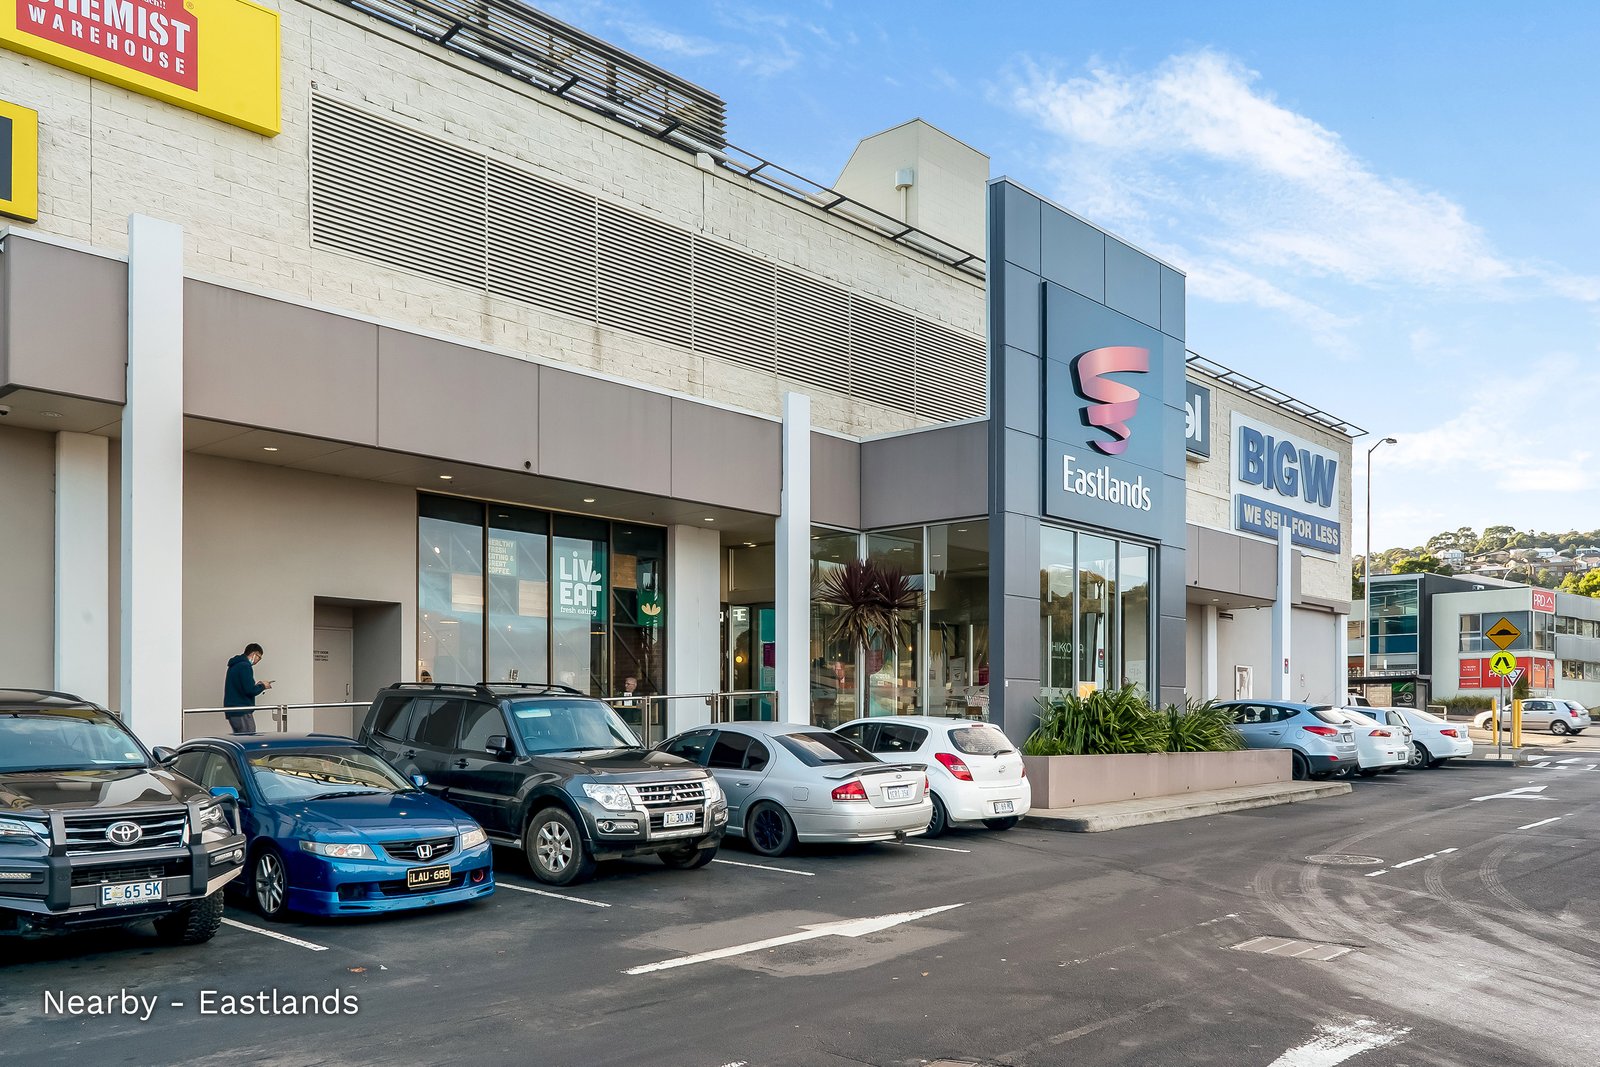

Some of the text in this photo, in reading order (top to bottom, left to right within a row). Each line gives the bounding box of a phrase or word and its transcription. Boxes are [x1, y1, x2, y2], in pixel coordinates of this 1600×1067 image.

[28, 4, 185, 75] WAREHOUSE
[35, 0, 191, 53] EMIST
[1063, 454, 1152, 512] Eastlands
[1243, 503, 1262, 526] WE
[1292, 516, 1312, 539] FOR
[1315, 523, 1338, 546] LESS
[560, 582, 602, 607] EAT
[560, 606, 597, 617] fresh eating
[104, 882, 160, 900] E 65 SK
